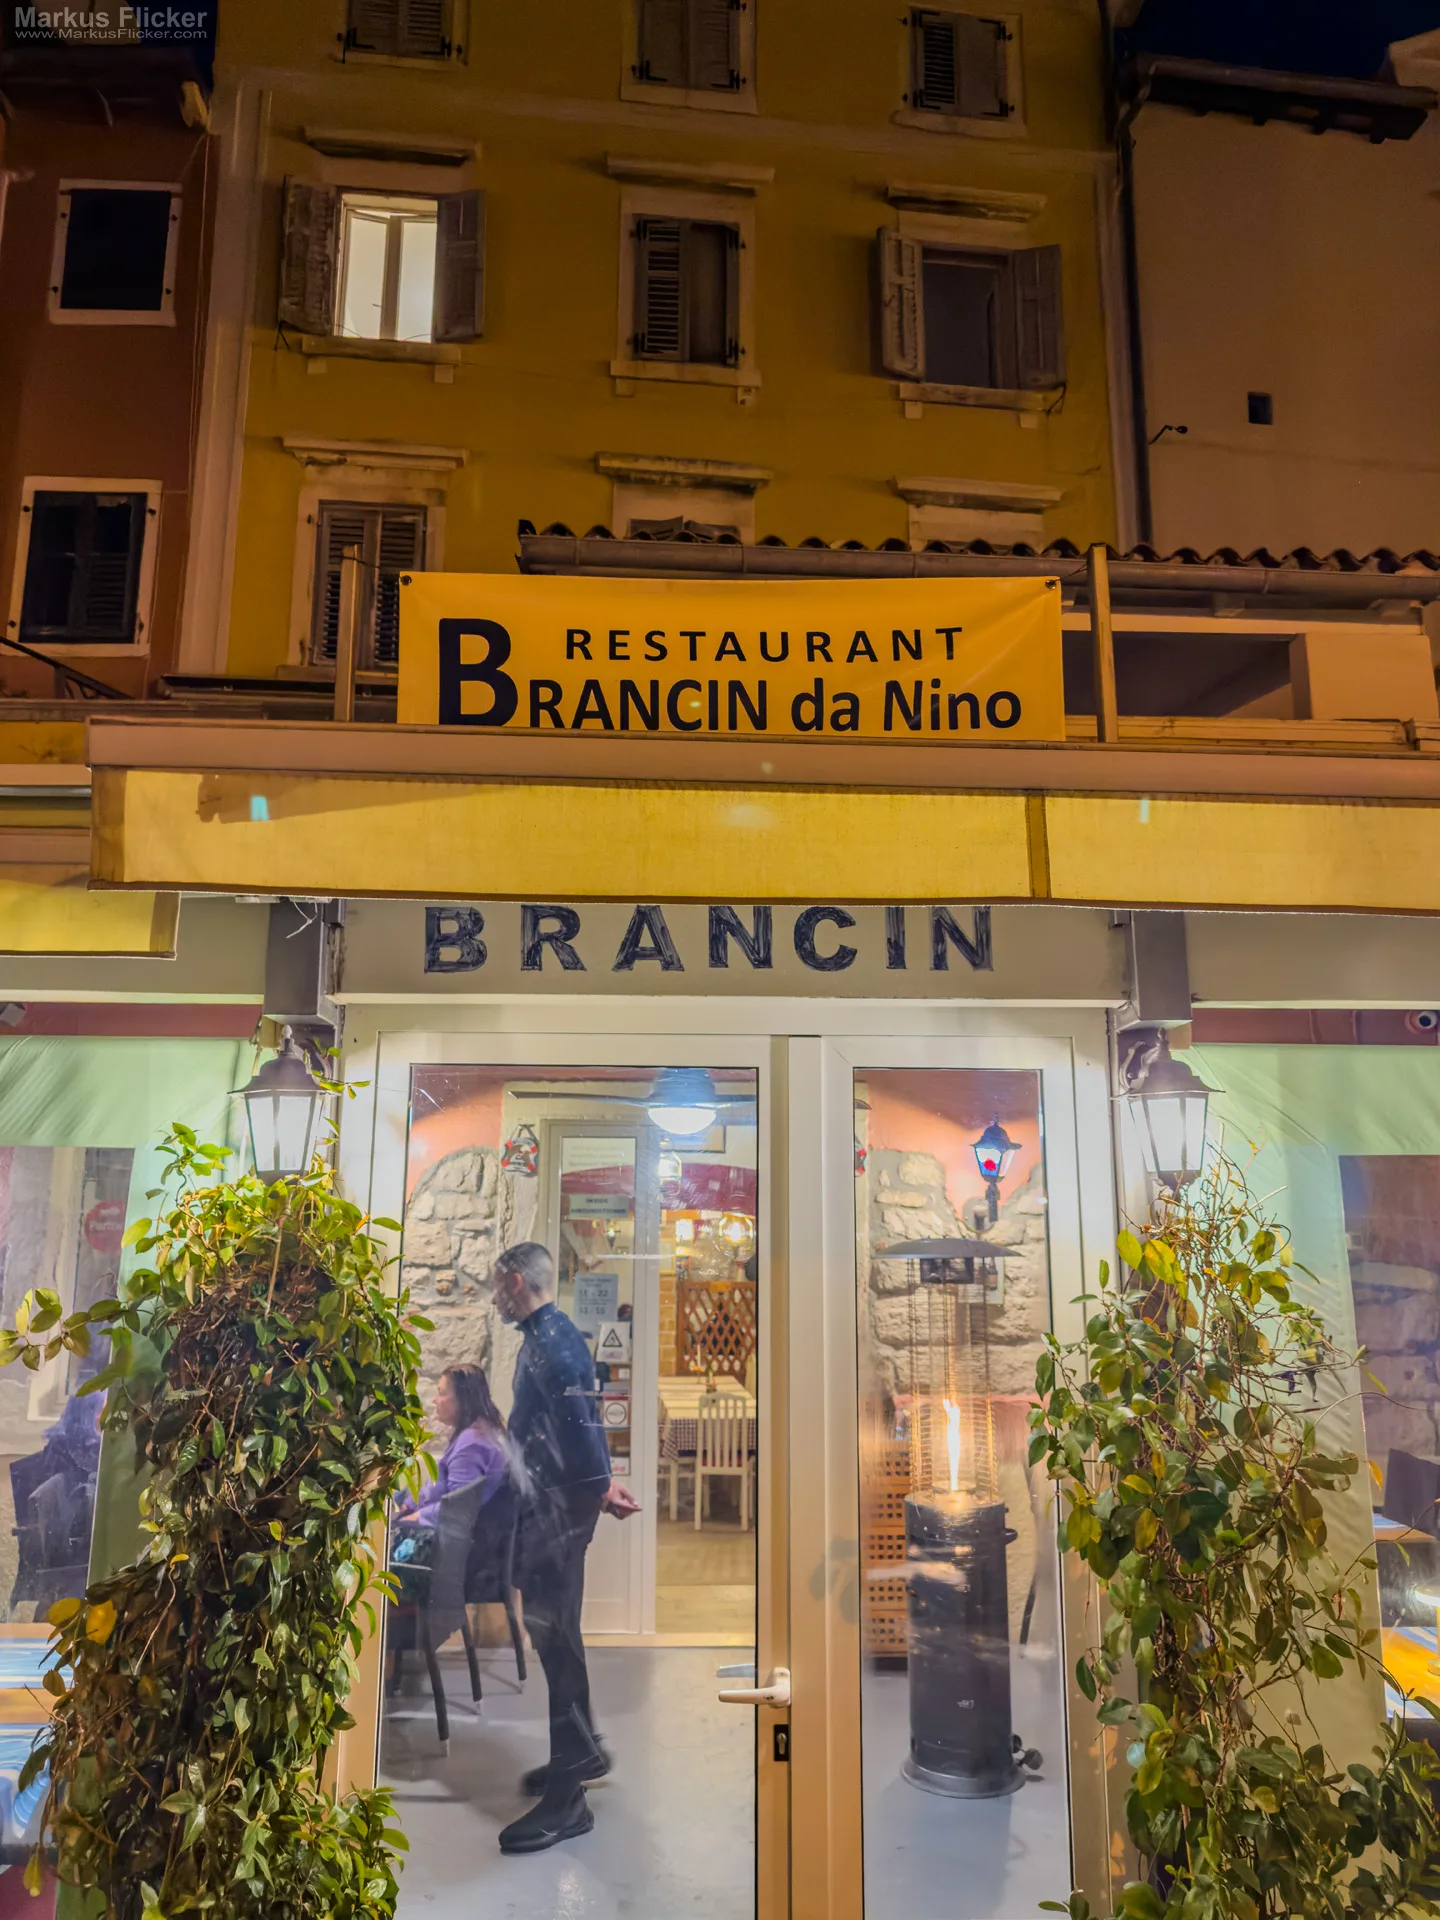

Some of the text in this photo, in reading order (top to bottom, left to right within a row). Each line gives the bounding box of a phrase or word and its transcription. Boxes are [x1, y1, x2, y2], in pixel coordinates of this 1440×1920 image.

[438, 617, 1022, 731] BRANCIN da Nino
[565, 626, 964, 663] RESTAURANT
[423, 904, 995, 973] BRANCIN
